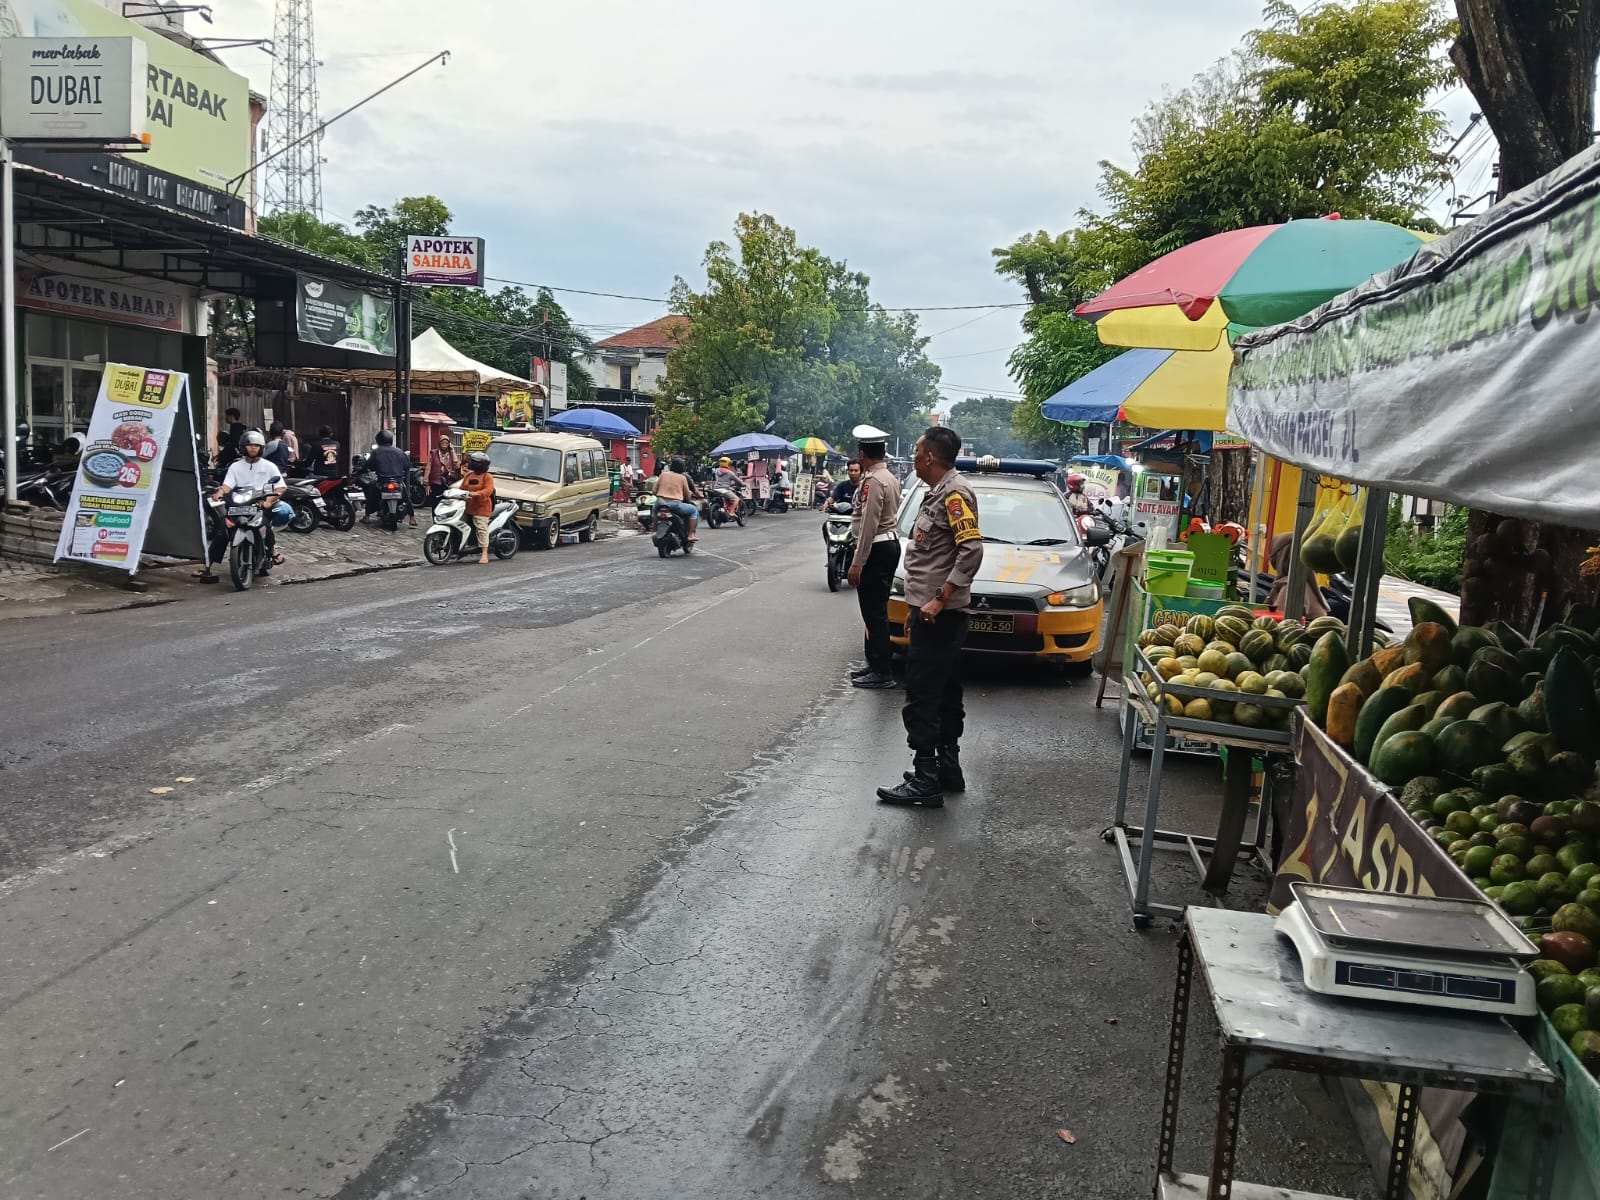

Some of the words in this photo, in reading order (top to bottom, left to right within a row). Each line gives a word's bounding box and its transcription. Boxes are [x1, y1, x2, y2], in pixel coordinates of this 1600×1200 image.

[32, 44, 102, 60] martabak
[30, 75, 102, 105] DUBAI
[411, 239, 474, 254] APOTEK
[412, 254, 472, 269] SAHARA
[28, 276, 107, 307] APOTEK
[109, 291, 177, 319] SAHARA
[114, 379, 138, 392] DUBAI
[1137, 502, 1157, 513] SATE
[1157, 503, 1179, 515] AYAM
[98, 515, 130, 524] GrabFood
